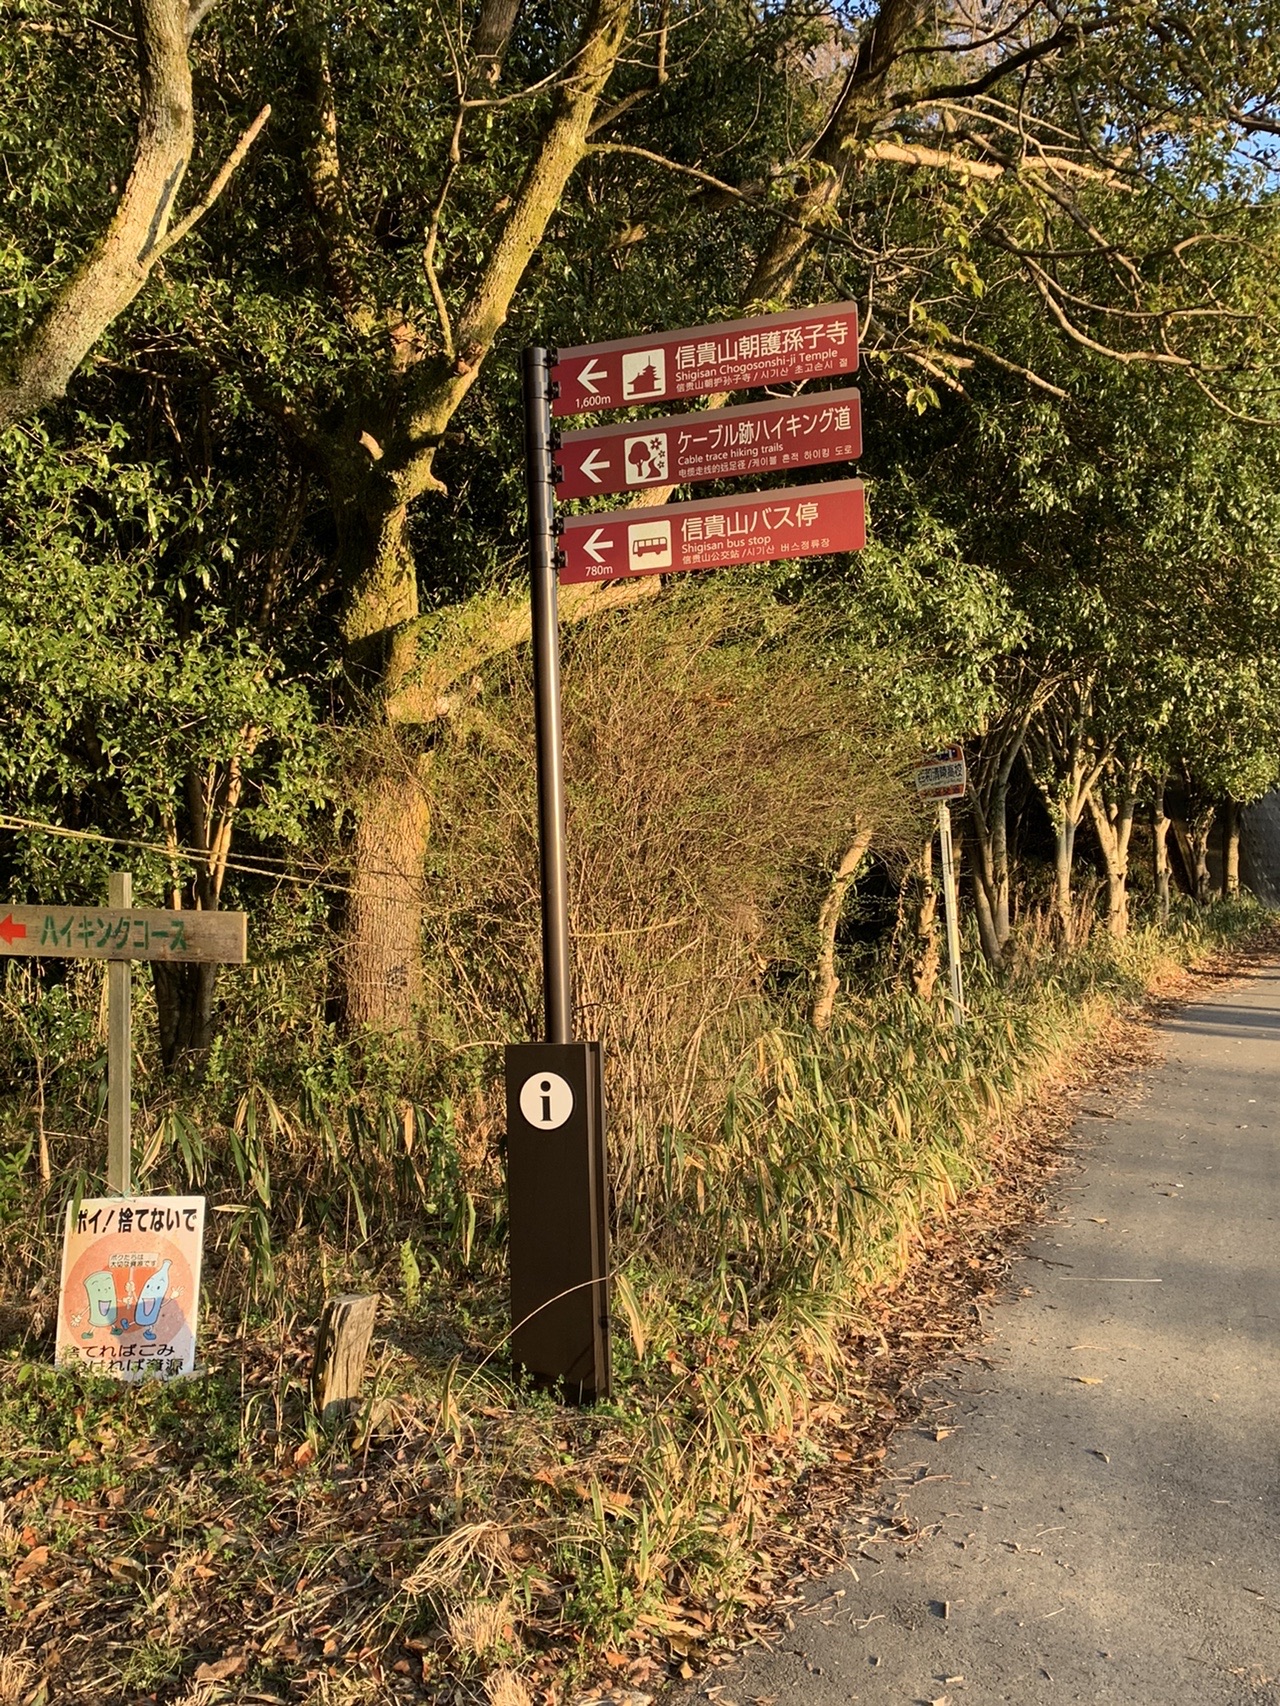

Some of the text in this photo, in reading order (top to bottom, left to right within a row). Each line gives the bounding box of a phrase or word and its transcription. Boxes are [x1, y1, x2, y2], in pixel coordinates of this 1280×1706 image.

[675, 320, 848, 370] 信貴山朝護孫子寺
[675, 349, 838, 382] Shigisan Chogosonshi-ji Temple
[760, 367, 789, 380] 시기산
[794, 361, 833, 374] 초고손시
[575, 394, 611, 409] 1,600m
[677, 405, 852, 454] ケーブル跡ハイキング道
[677, 442, 784, 466] Cable trace hiking trails
[804, 447, 830, 460] 하이킹
[835, 444, 853, 455] 도로
[681, 502, 819, 542] 信貴山バス停
[681, 535, 772, 555] Shigisan bus stop
[780, 537, 830, 553] 버스정류장
[585, 564, 613, 577] 780m
[40, 914, 187, 951] ハイキングコース
[540, 1080, 553, 1122] i
